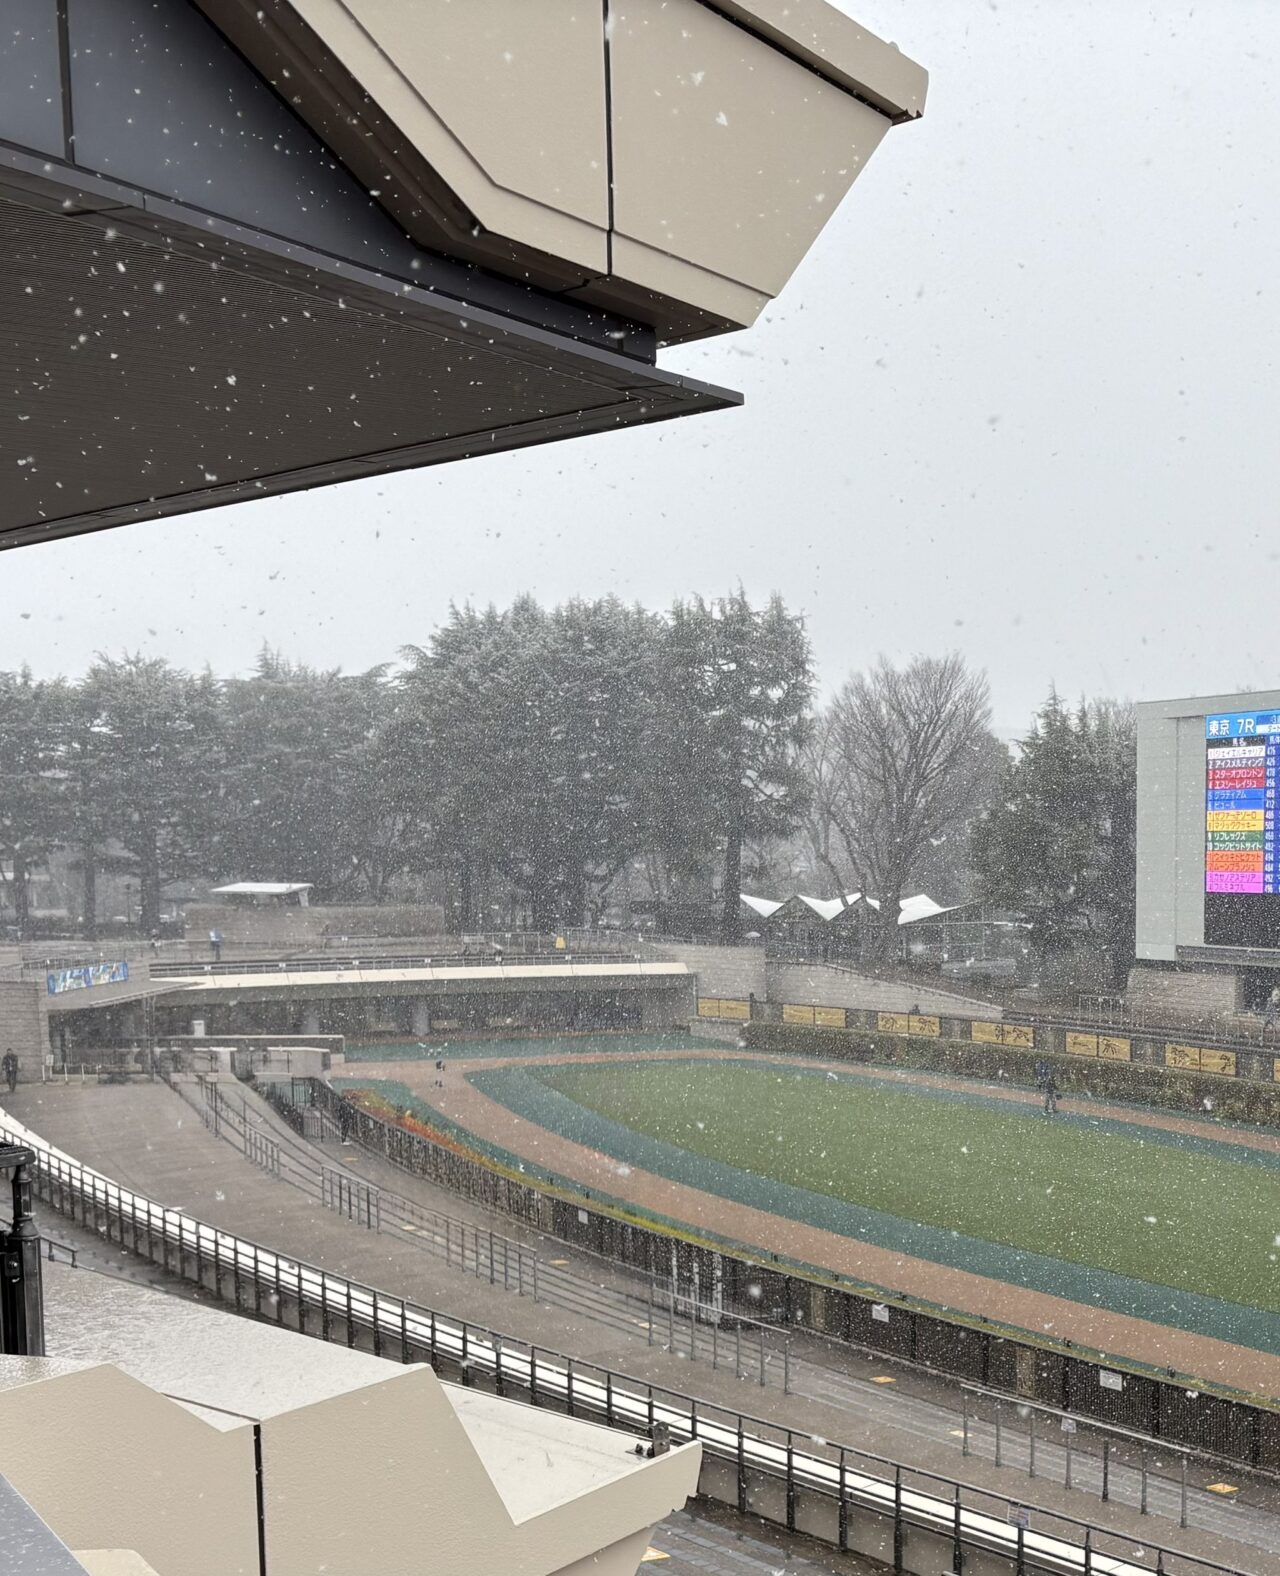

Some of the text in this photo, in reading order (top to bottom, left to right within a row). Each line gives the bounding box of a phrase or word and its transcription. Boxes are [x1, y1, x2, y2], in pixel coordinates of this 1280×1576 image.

[1209, 719, 1255, 737] 東京 7R
[1232, 738, 1246, 747] 馬名
[1216, 758, 1263, 769] アイスメルティング
[1214, 832, 1246, 841] リフレックス
